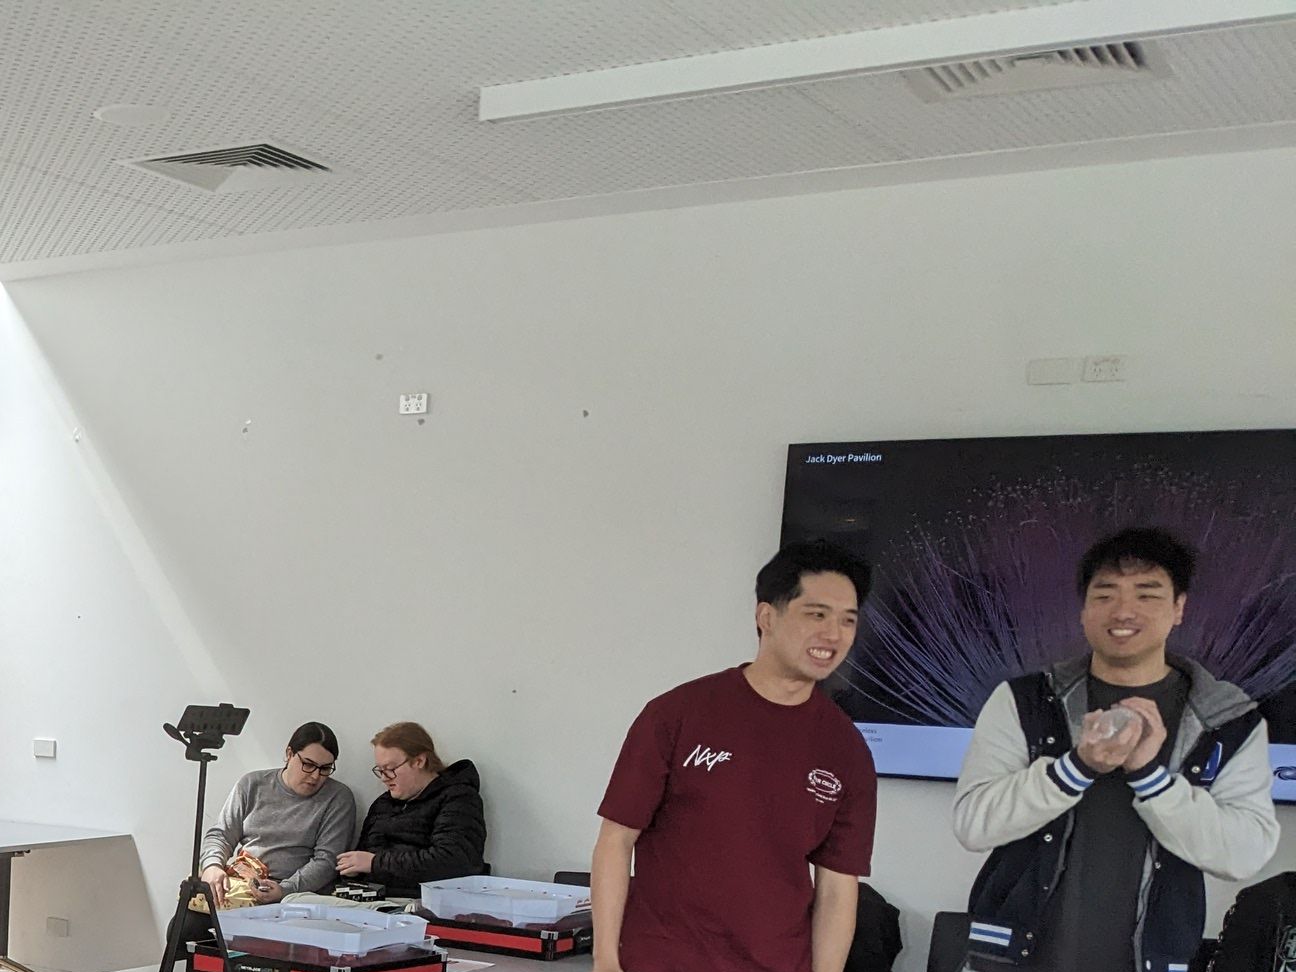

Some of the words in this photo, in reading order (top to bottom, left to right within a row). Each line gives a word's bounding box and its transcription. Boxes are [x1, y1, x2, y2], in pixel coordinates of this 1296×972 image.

[805, 454, 825, 463] Jack
[826, 454, 846, 465] Dyer
[847, 452, 882, 462] Pavilion
